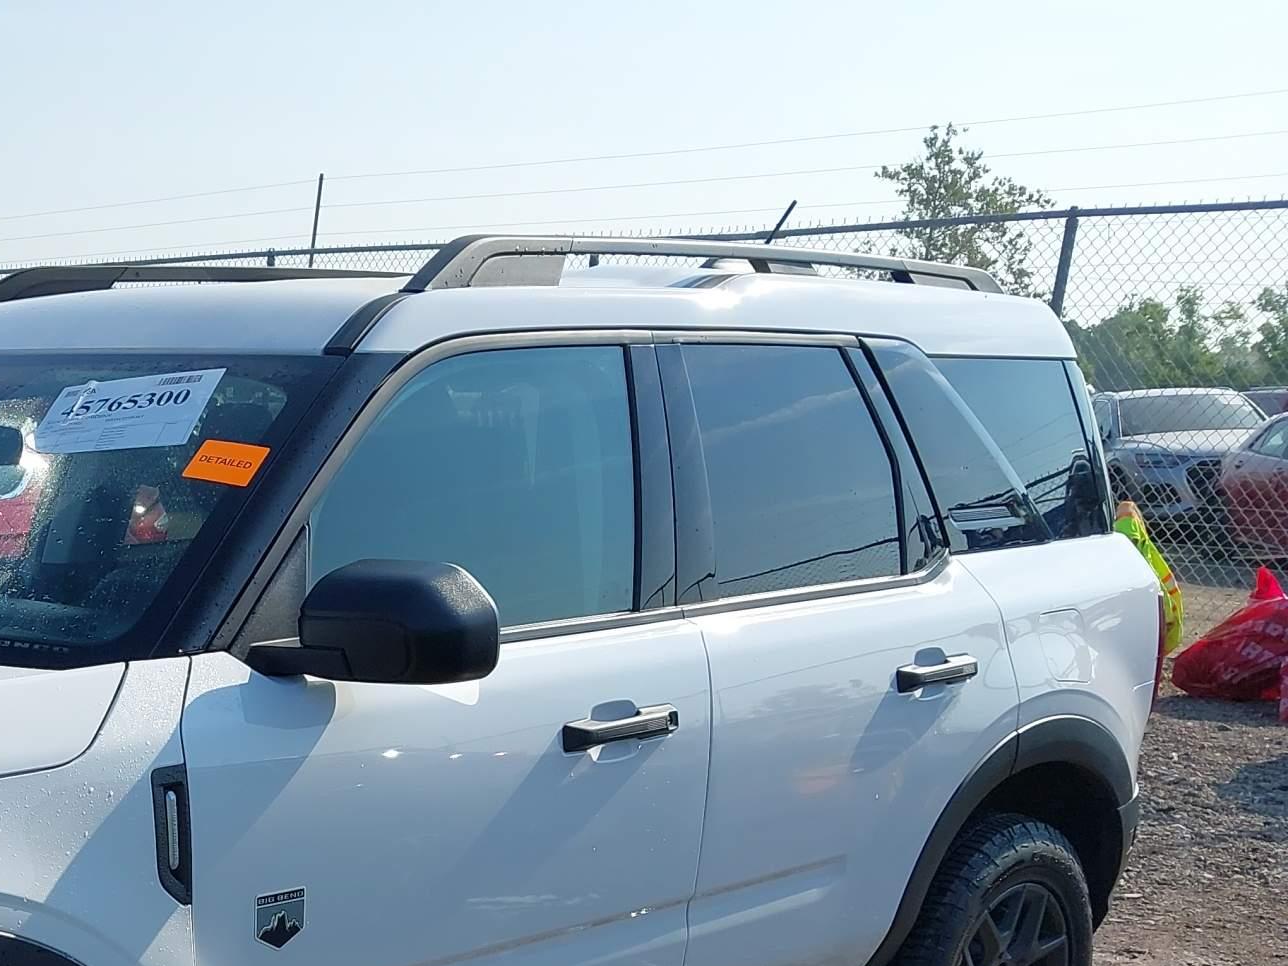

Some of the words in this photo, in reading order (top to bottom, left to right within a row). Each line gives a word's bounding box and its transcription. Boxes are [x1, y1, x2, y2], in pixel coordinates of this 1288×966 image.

[61, 389, 191, 417] 45765300
[199, 454, 253, 469] DETAILED
[258, 896, 275, 905] BIG
[277, 890, 304, 901] BEND
